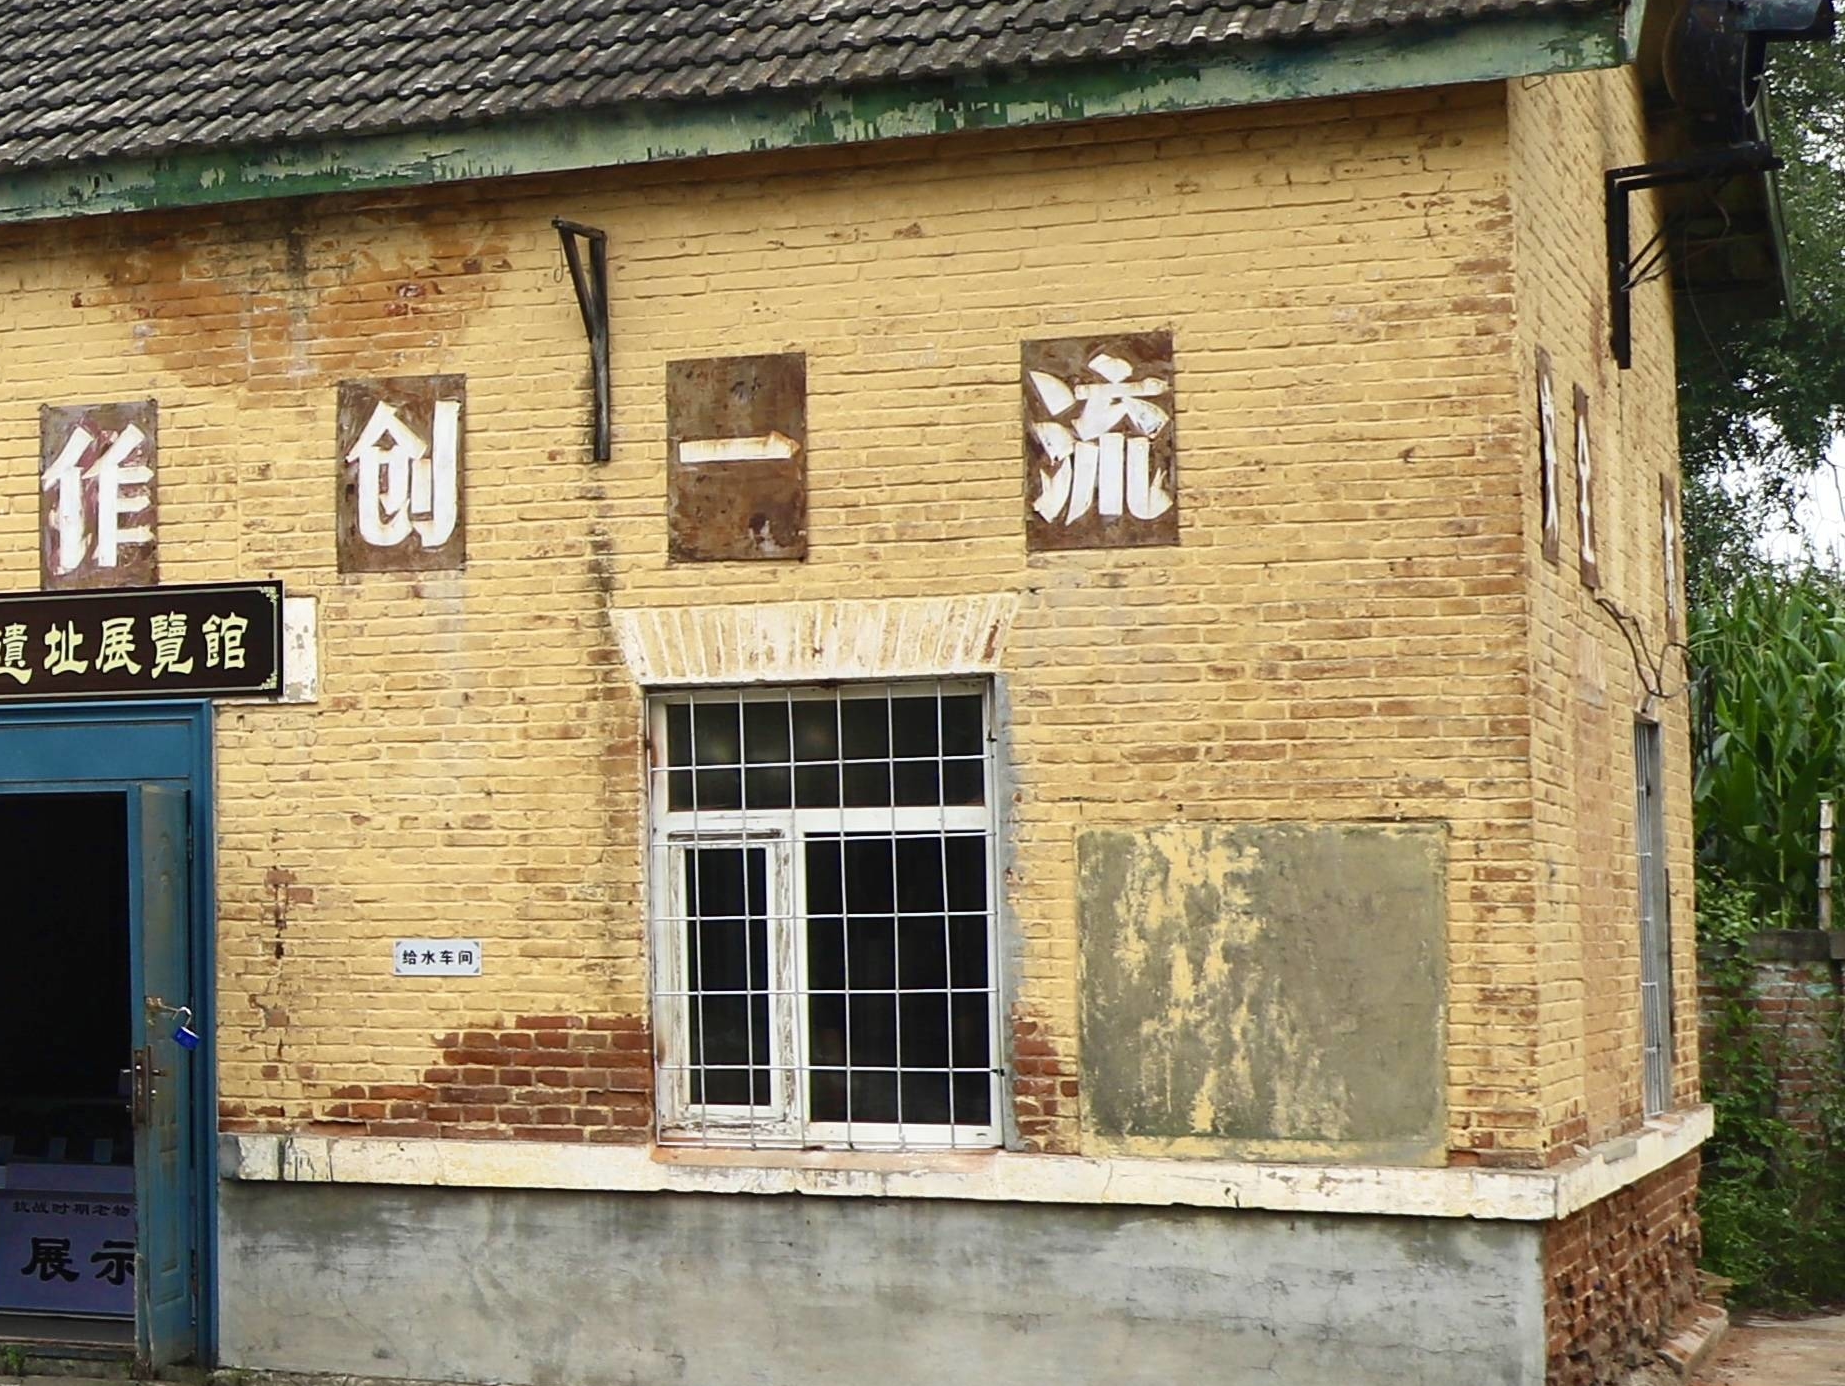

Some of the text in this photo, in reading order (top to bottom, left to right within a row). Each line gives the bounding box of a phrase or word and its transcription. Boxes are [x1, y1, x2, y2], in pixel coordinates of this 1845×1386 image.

[402, 949, 473, 965] 给水车间
[20, 1237, 135, 1285] 展示
